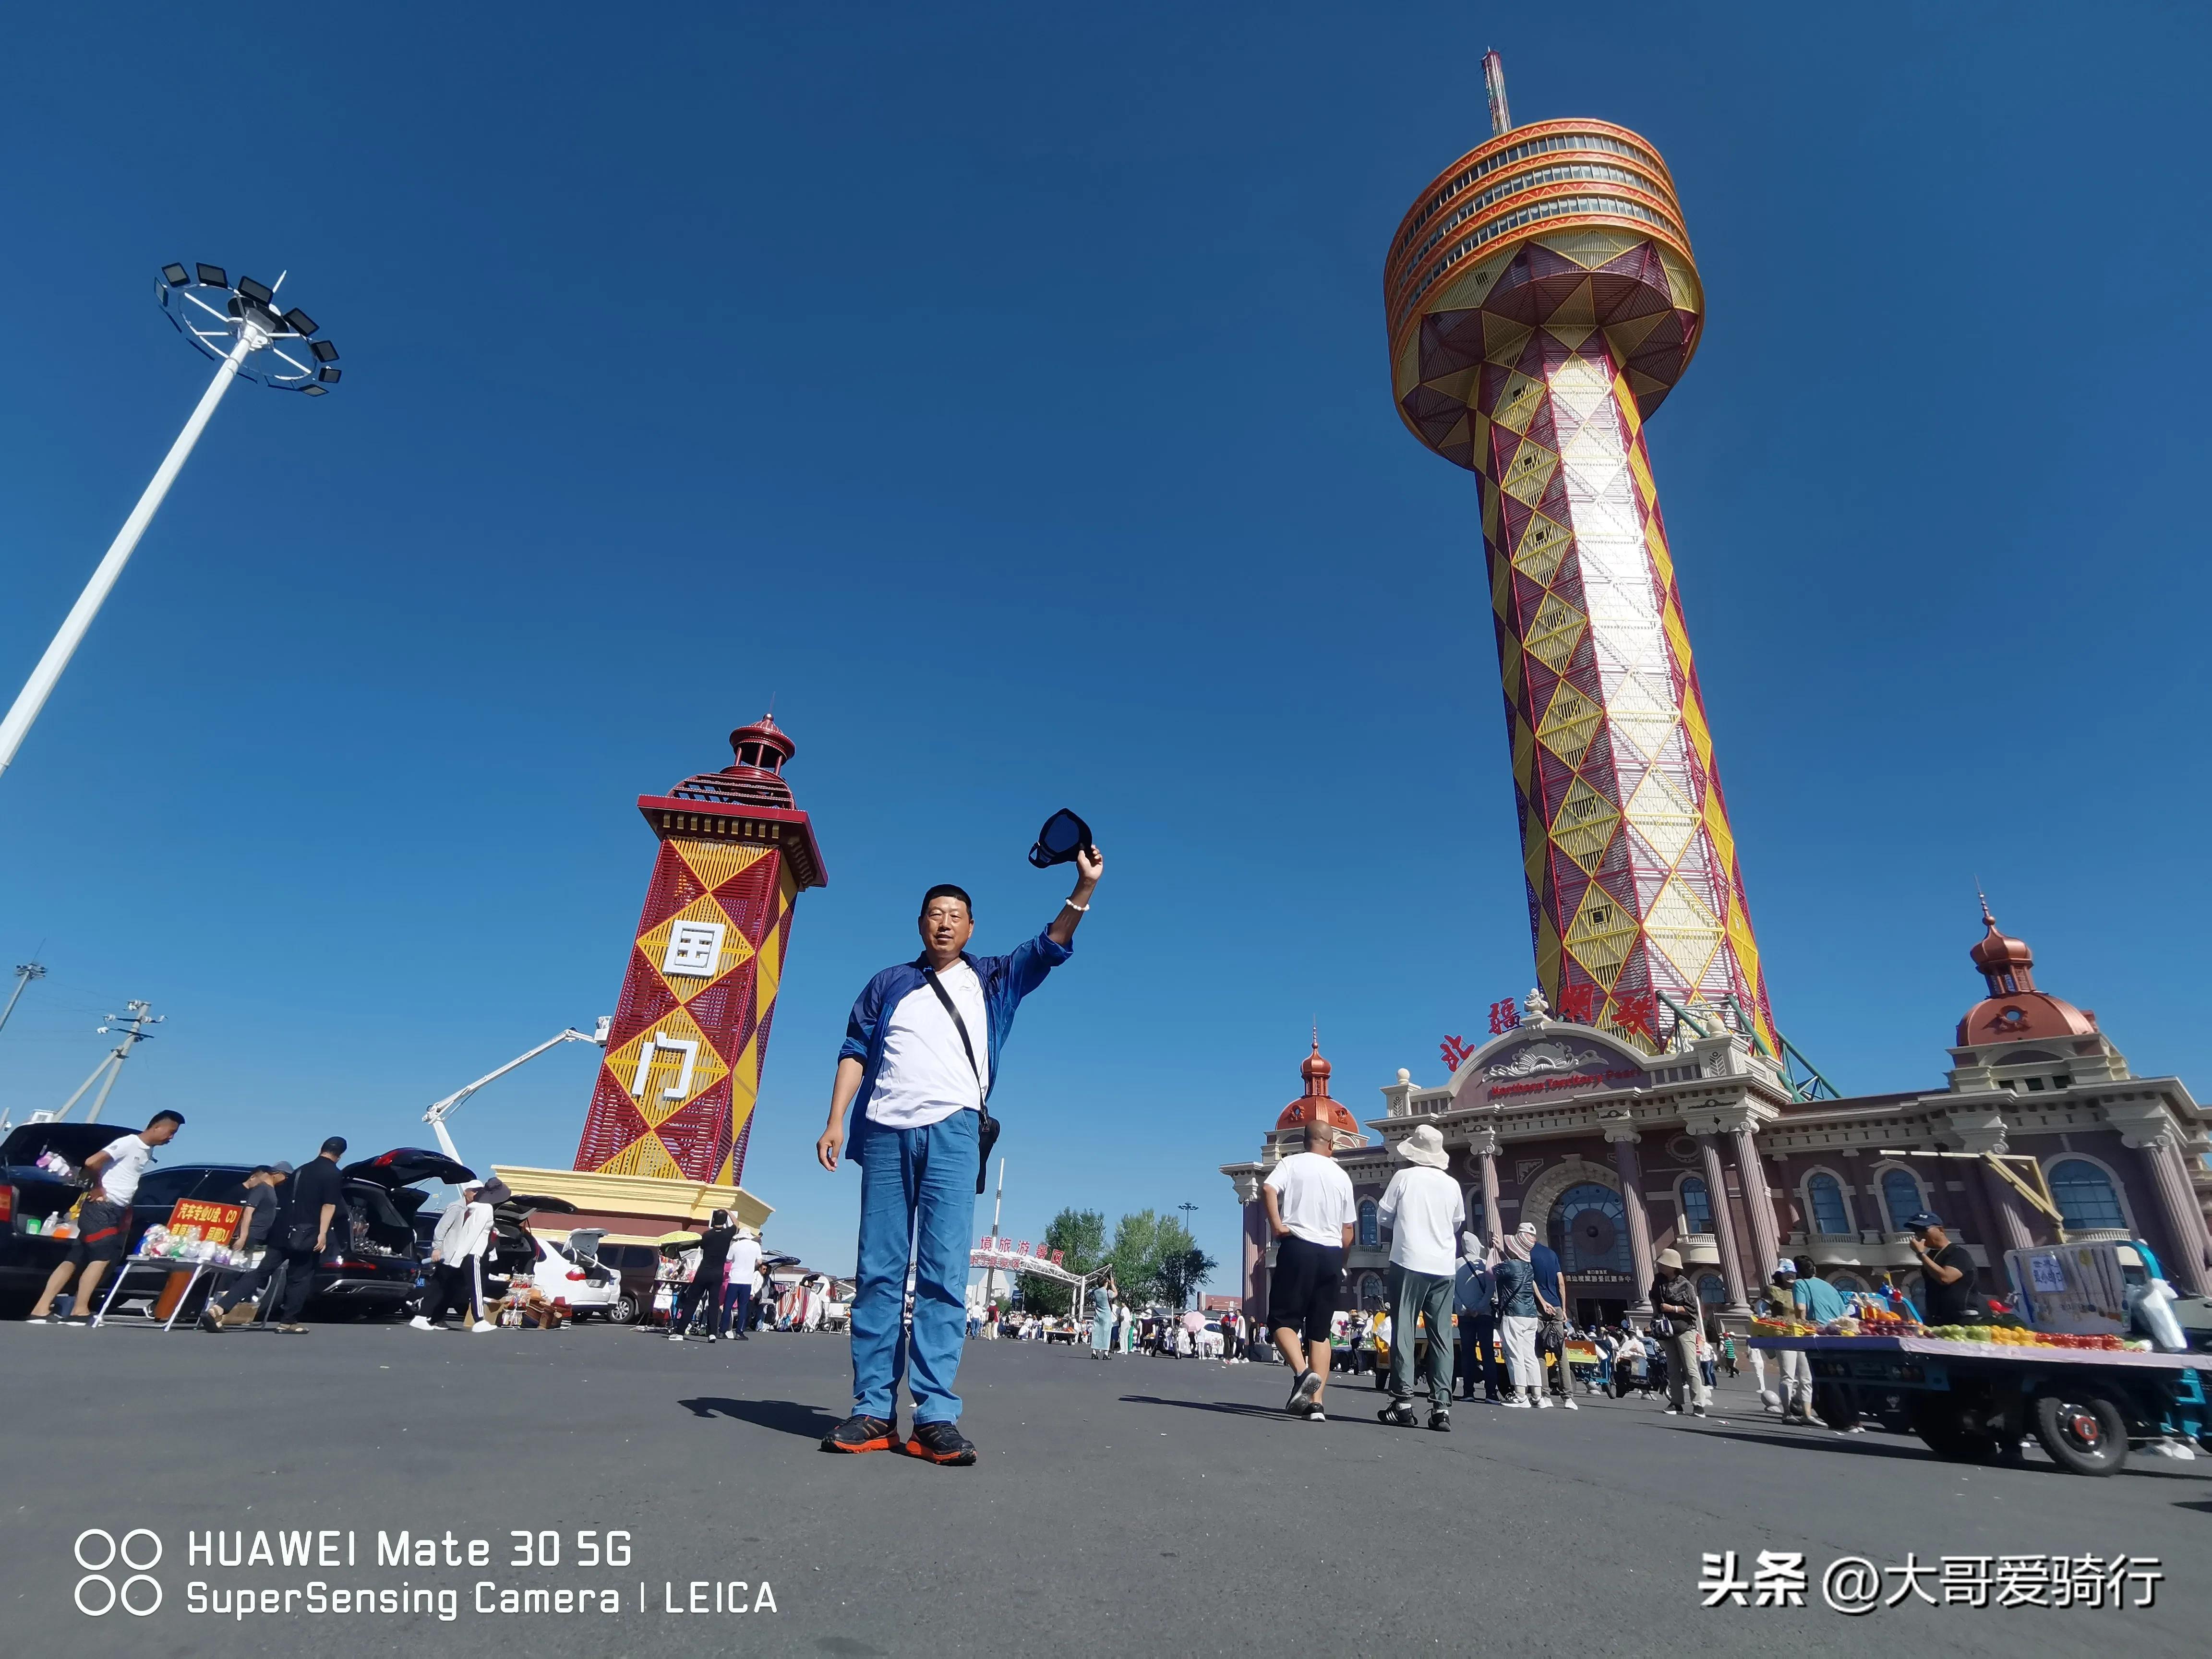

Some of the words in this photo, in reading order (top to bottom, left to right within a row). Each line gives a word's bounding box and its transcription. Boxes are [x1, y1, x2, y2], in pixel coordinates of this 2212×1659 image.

[631, 919, 726, 1100] 国门
[972, 1236, 1065, 1266] 境旅游景区
